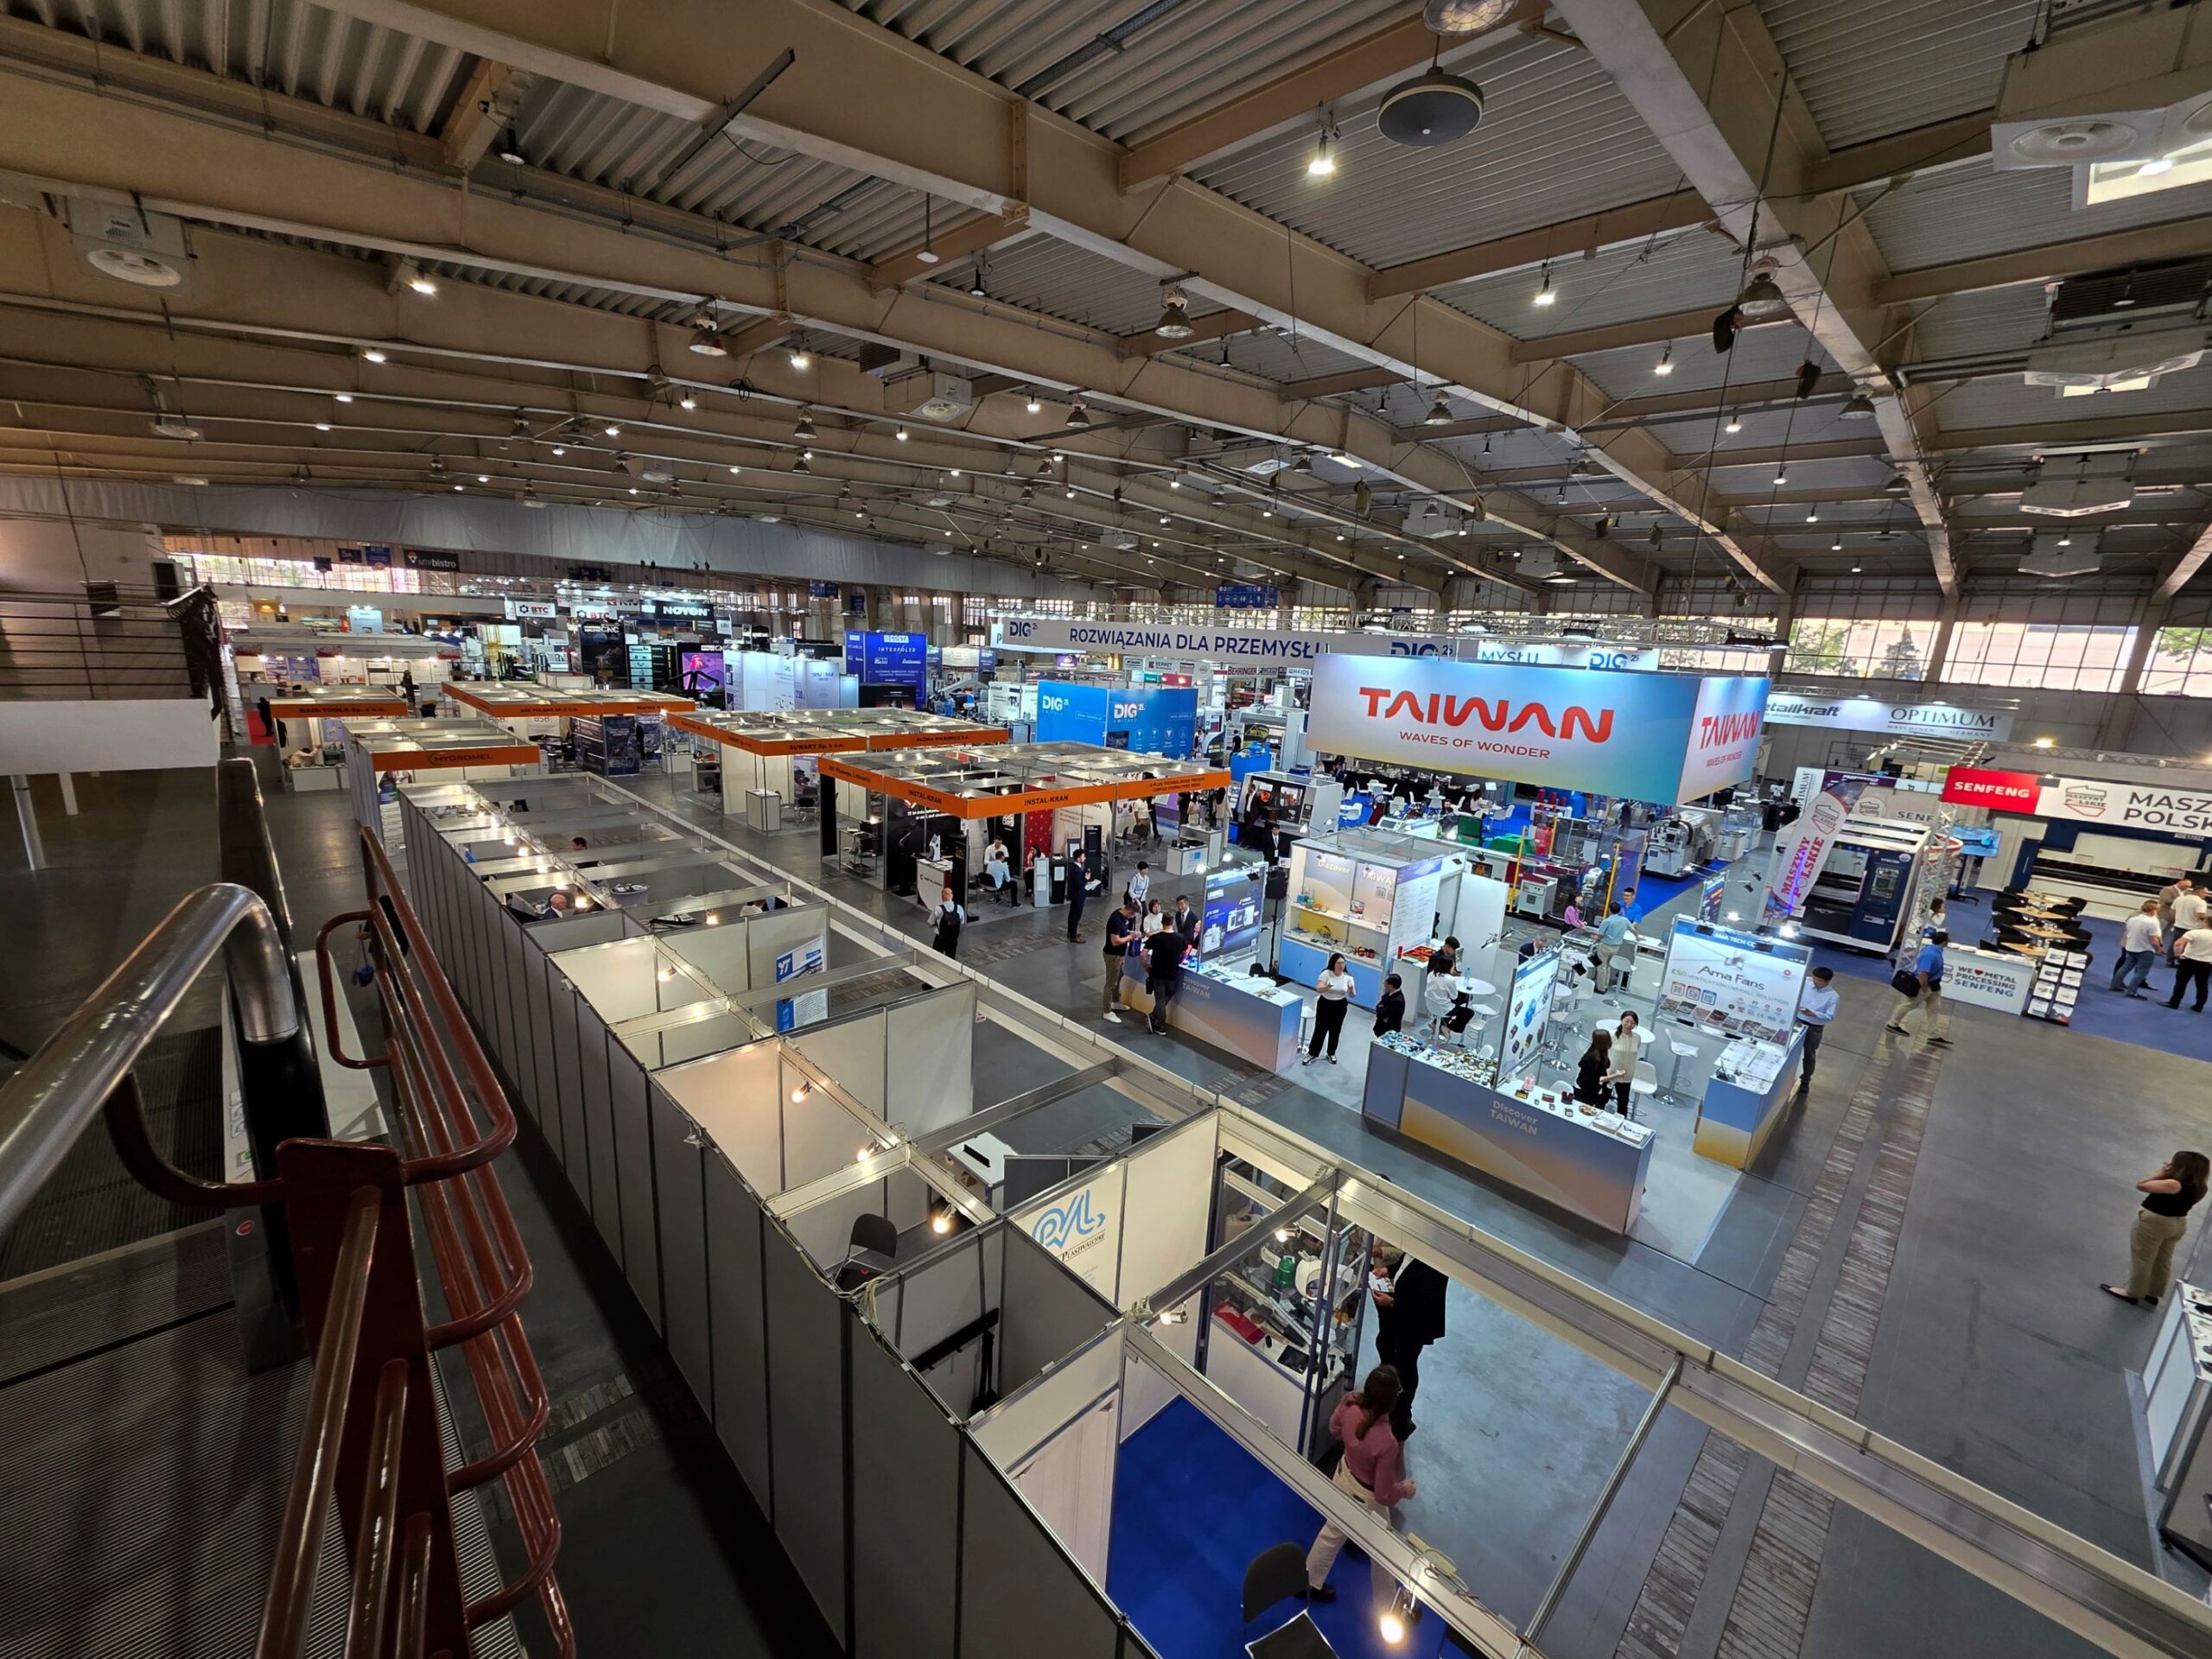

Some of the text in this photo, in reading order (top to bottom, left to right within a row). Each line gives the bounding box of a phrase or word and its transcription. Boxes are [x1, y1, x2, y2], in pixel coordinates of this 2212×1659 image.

[1070, 628, 1330, 659] ROZWIĄZANIA DLA PRZEMYSŁU
[1042, 696, 1064, 711] DIG
[1114, 703, 1137, 719] DIG
[1359, 686, 1614, 744] TAIWAN
[1891, 708, 1995, 728] OPTIMUM
[1700, 710, 1760, 750] TAIWAN
[1399, 731, 1550, 760] WAVES OF WONDER
[434, 753, 493, 762] HYDROMEL
[1796, 772, 1811, 810] PTIMUM
[1954, 781, 2031, 798] SENFENG
[1024, 794, 1069, 806] INSTAL-KRAN
[1781, 836, 1810, 895] MASZYNY
[1792, 836, 1825, 899] POLSKIE
[1713, 932, 1729, 941] AMA
[1730, 936, 1746, 945] TECH
[1697, 965, 1733, 982] Ama
[1734, 973, 1765, 991] Fans
[1955, 972, 2016, 990] PROCESSING
[1958, 965, 2017, 983] WE METAL
[1954, 978, 2014, 997] SENFENG
[1492, 1100, 1538, 1124] Discover
